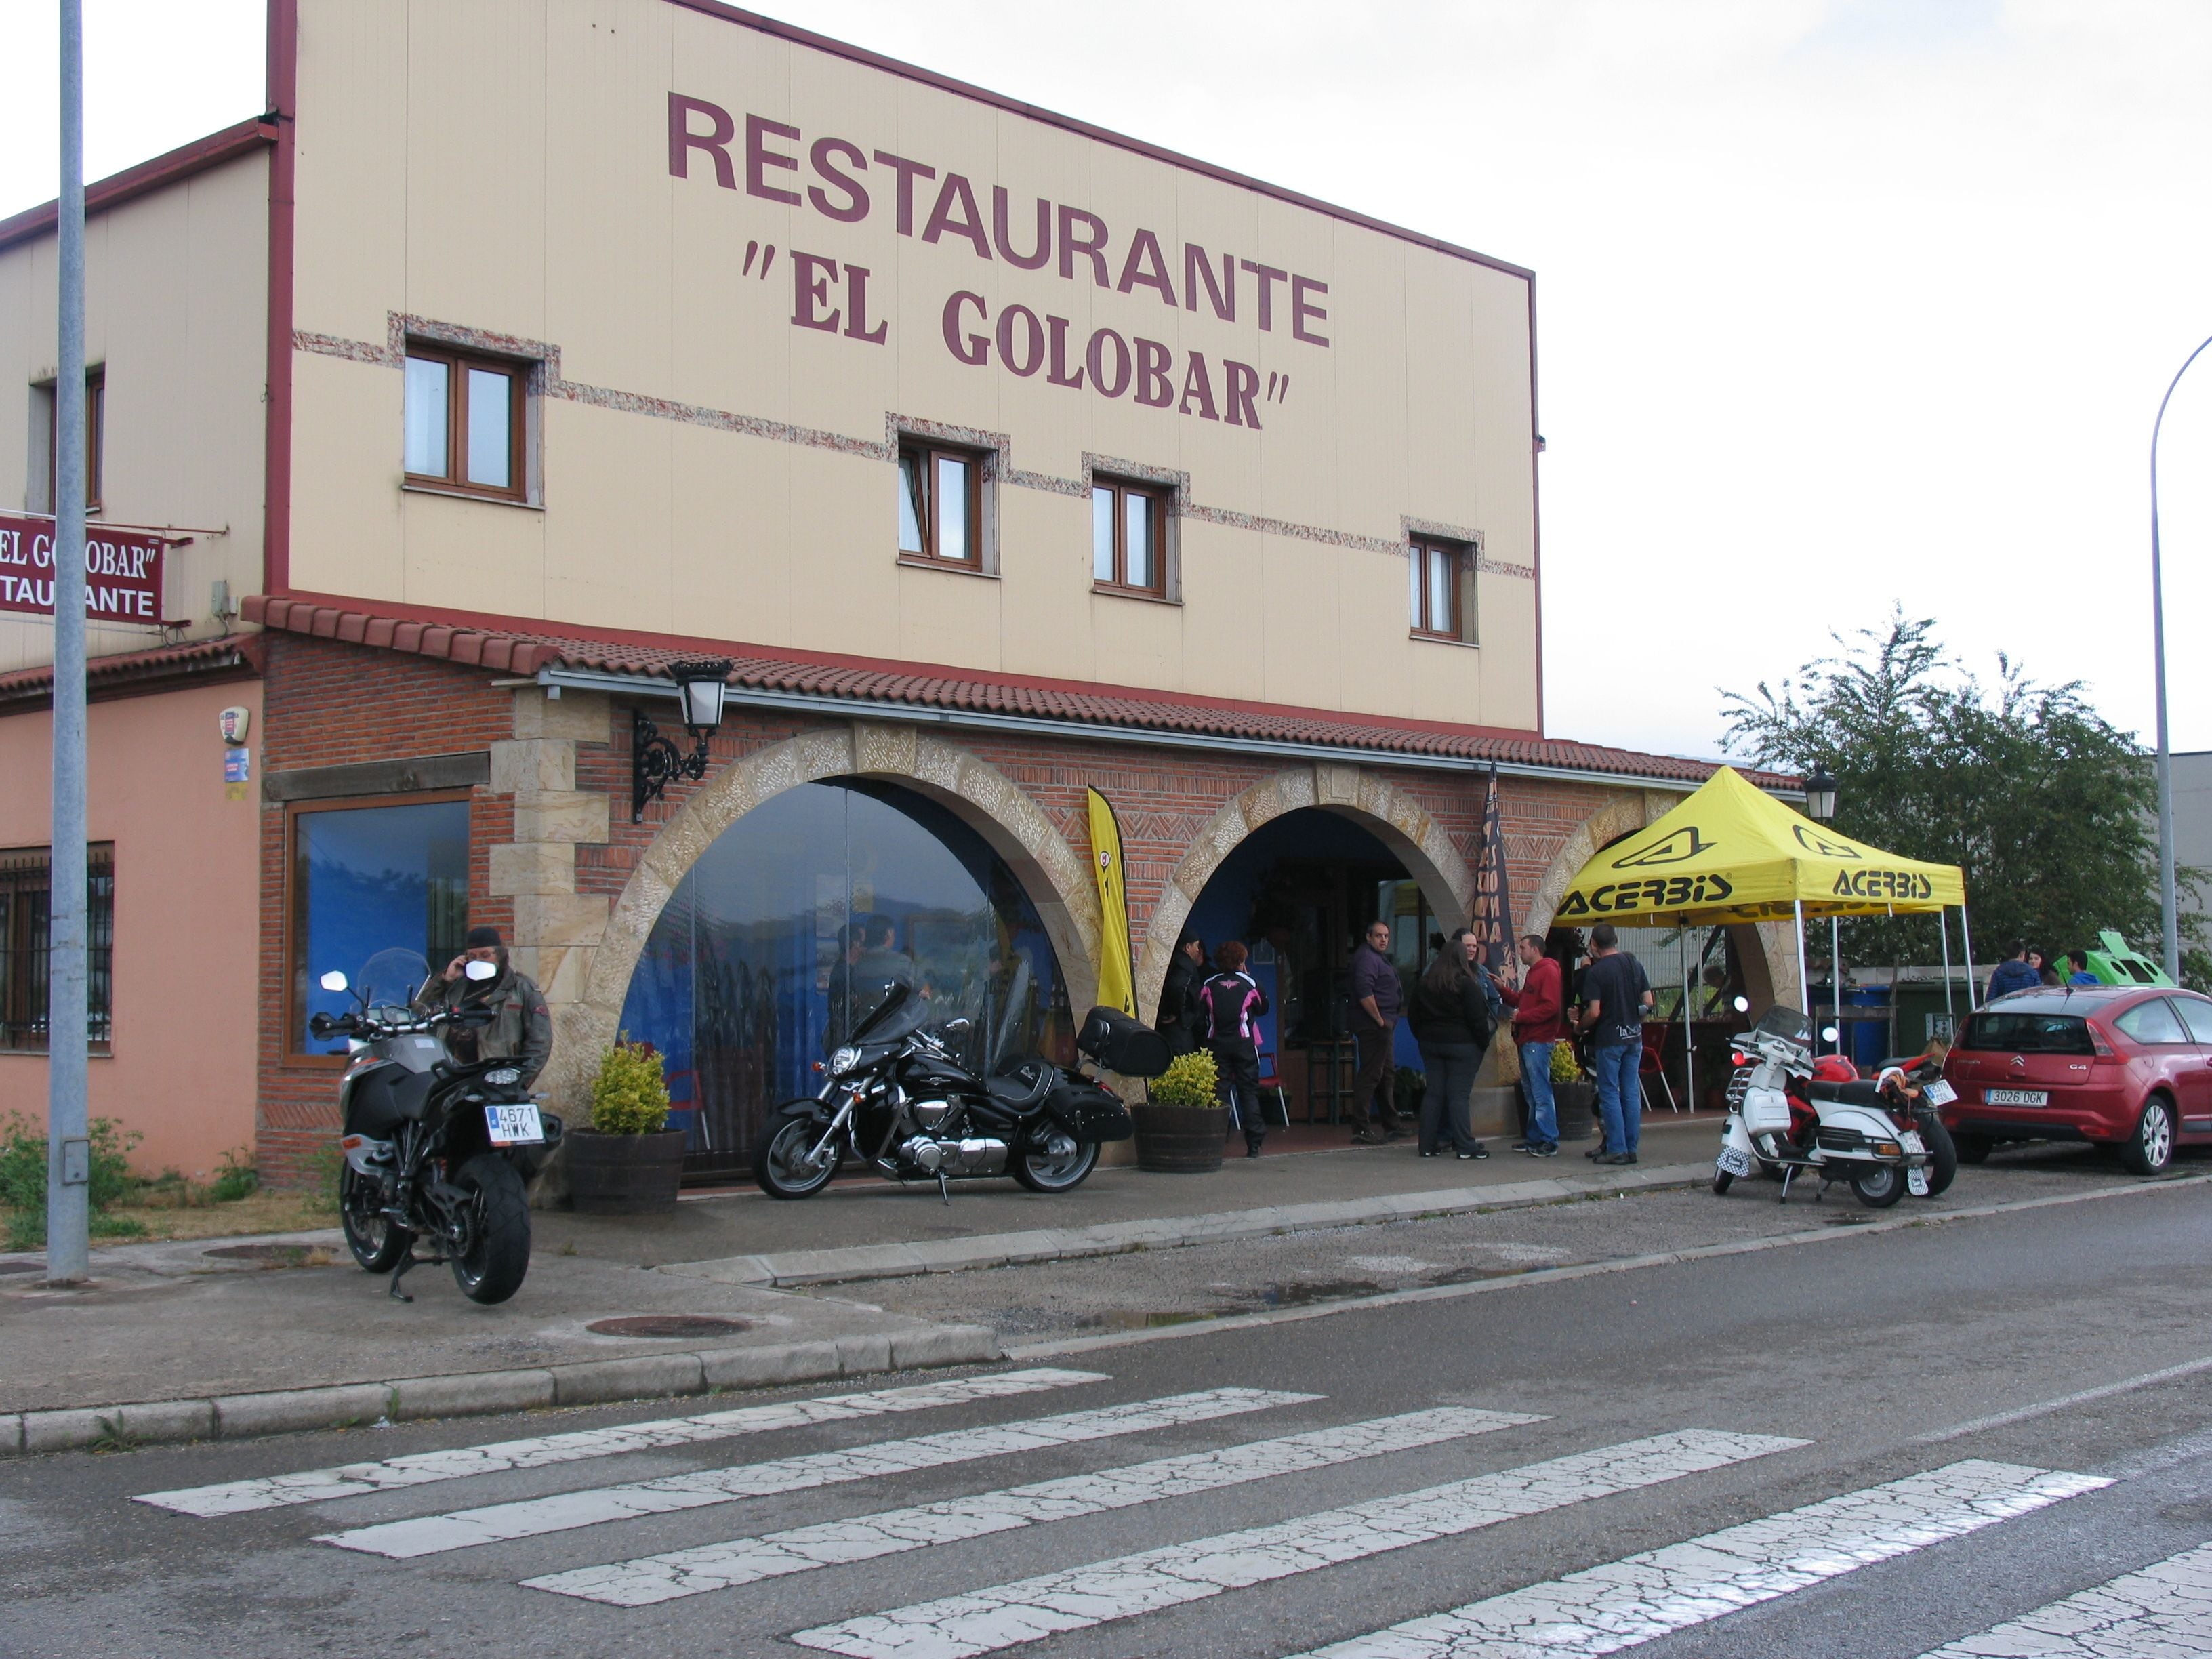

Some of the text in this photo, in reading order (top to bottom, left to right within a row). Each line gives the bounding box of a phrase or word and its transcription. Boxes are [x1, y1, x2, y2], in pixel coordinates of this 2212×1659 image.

[668, 91, 1330, 348] RESTAURANTE
[942, 290, 1290, 430] GOLOBAR"
[33, 533, 156, 579] GOBAR"
[0, 575, 155, 617] TAUANTE
[499, 1107, 534, 1123] 4671
[1994, 1091, 2043, 1104] 3026 DGK
[501, 1122, 531, 1138] HWK
